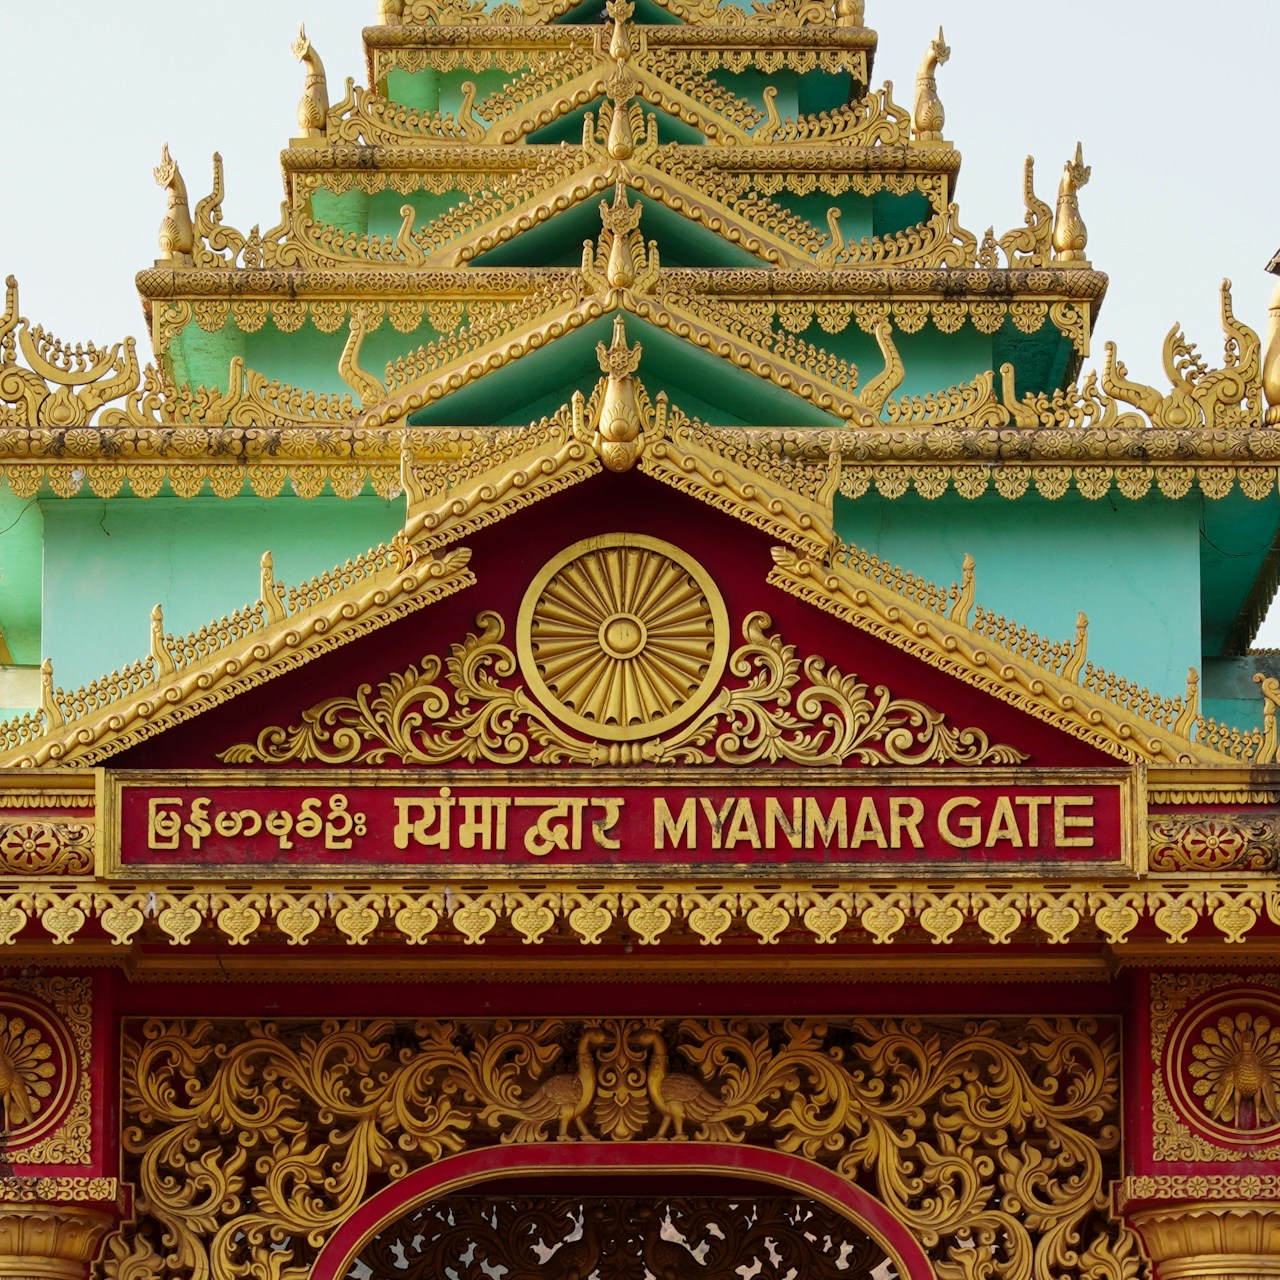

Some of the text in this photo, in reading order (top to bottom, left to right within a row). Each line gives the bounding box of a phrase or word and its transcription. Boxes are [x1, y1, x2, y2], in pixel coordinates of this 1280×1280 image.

[514, 797, 625, 856] द्वार
[653, 796, 1095, 850] MYANMAR GATE
